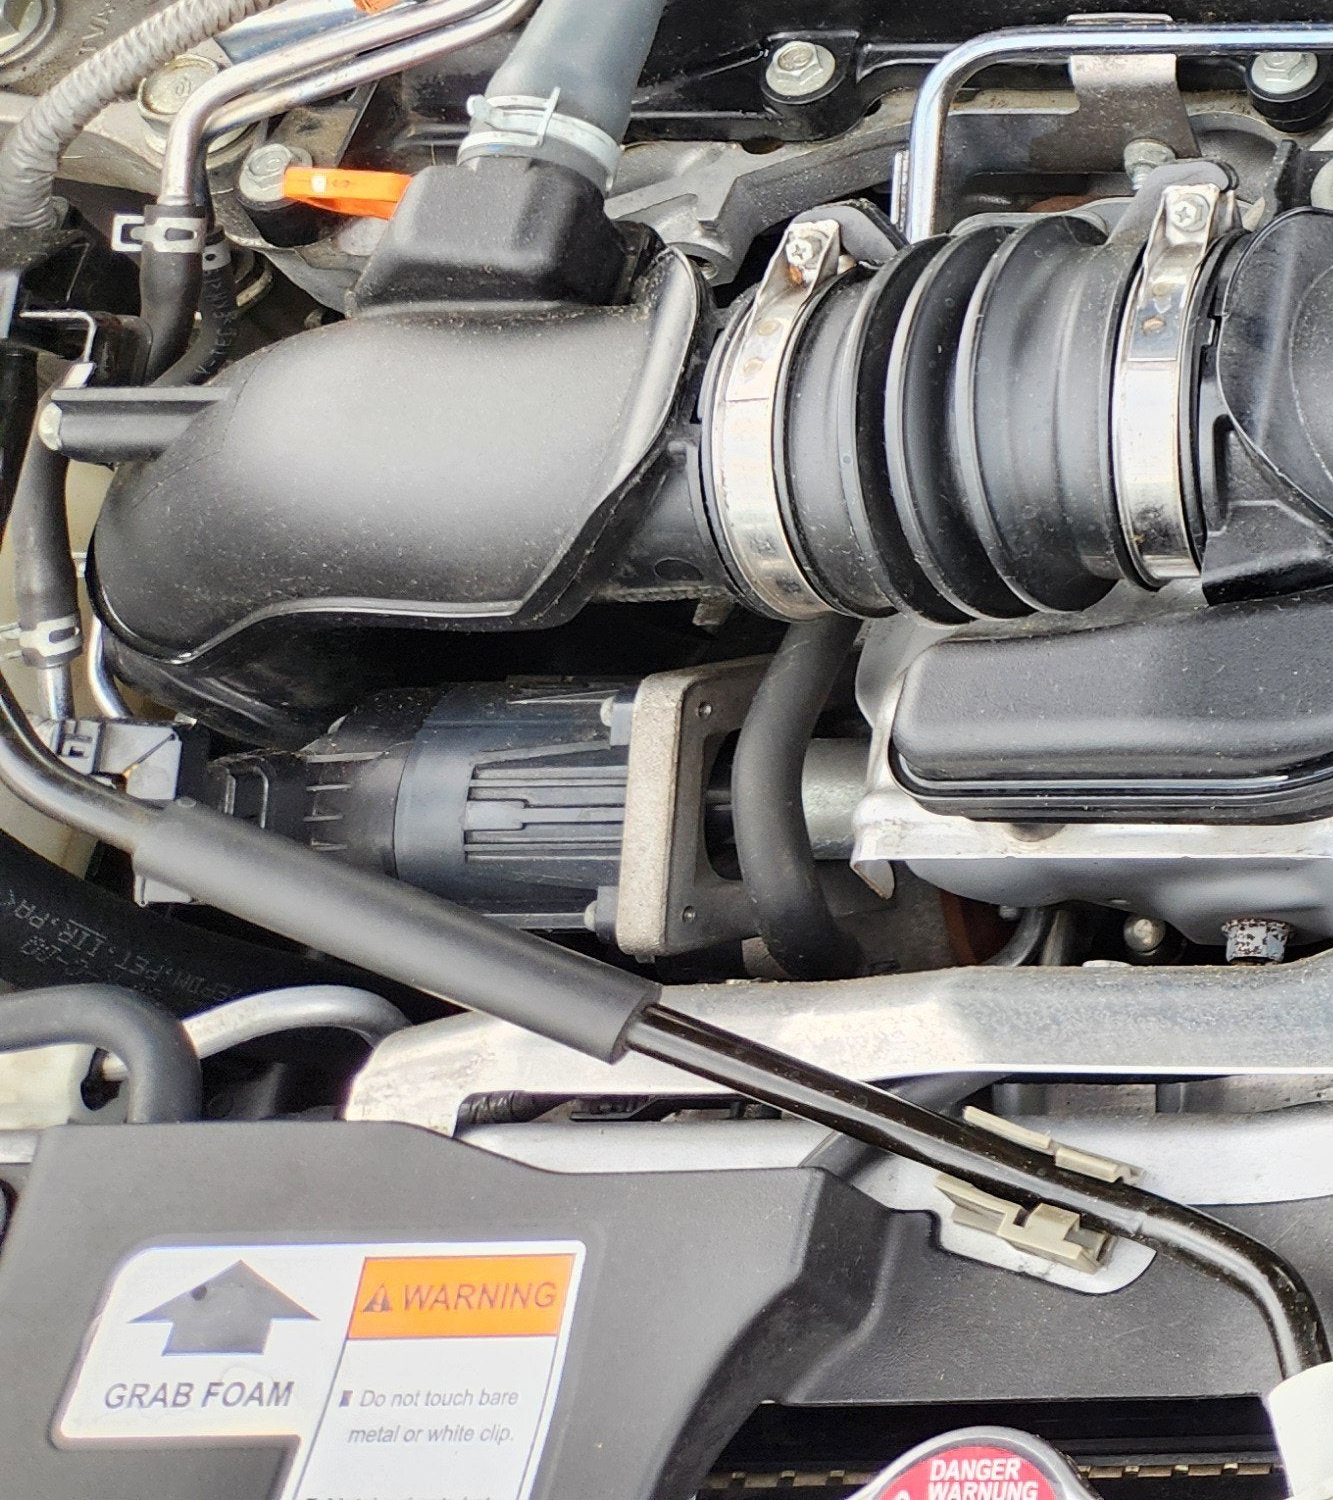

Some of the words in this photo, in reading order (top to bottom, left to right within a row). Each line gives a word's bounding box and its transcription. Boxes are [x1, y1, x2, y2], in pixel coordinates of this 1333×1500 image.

[403, 1281, 558, 1313] WARNING
[105, 1382, 193, 1409] GRAB
[201, 1380, 295, 1408] FOAM
[360, 1390, 385, 1408] Do
[389, 1390, 420, 1407] not
[424, 1389, 474, 1407] touch
[478, 1388, 519, 1406] bare
[348, 1425, 399, 1443] metal
[403, 1429, 424, 1443] or
[427, 1424, 475, 1442] white
[480, 1423, 515, 1445] clip.
[930, 1458, 1022, 1480] DANGER
[928, 1481, 1039, 1500] WARNUNG
